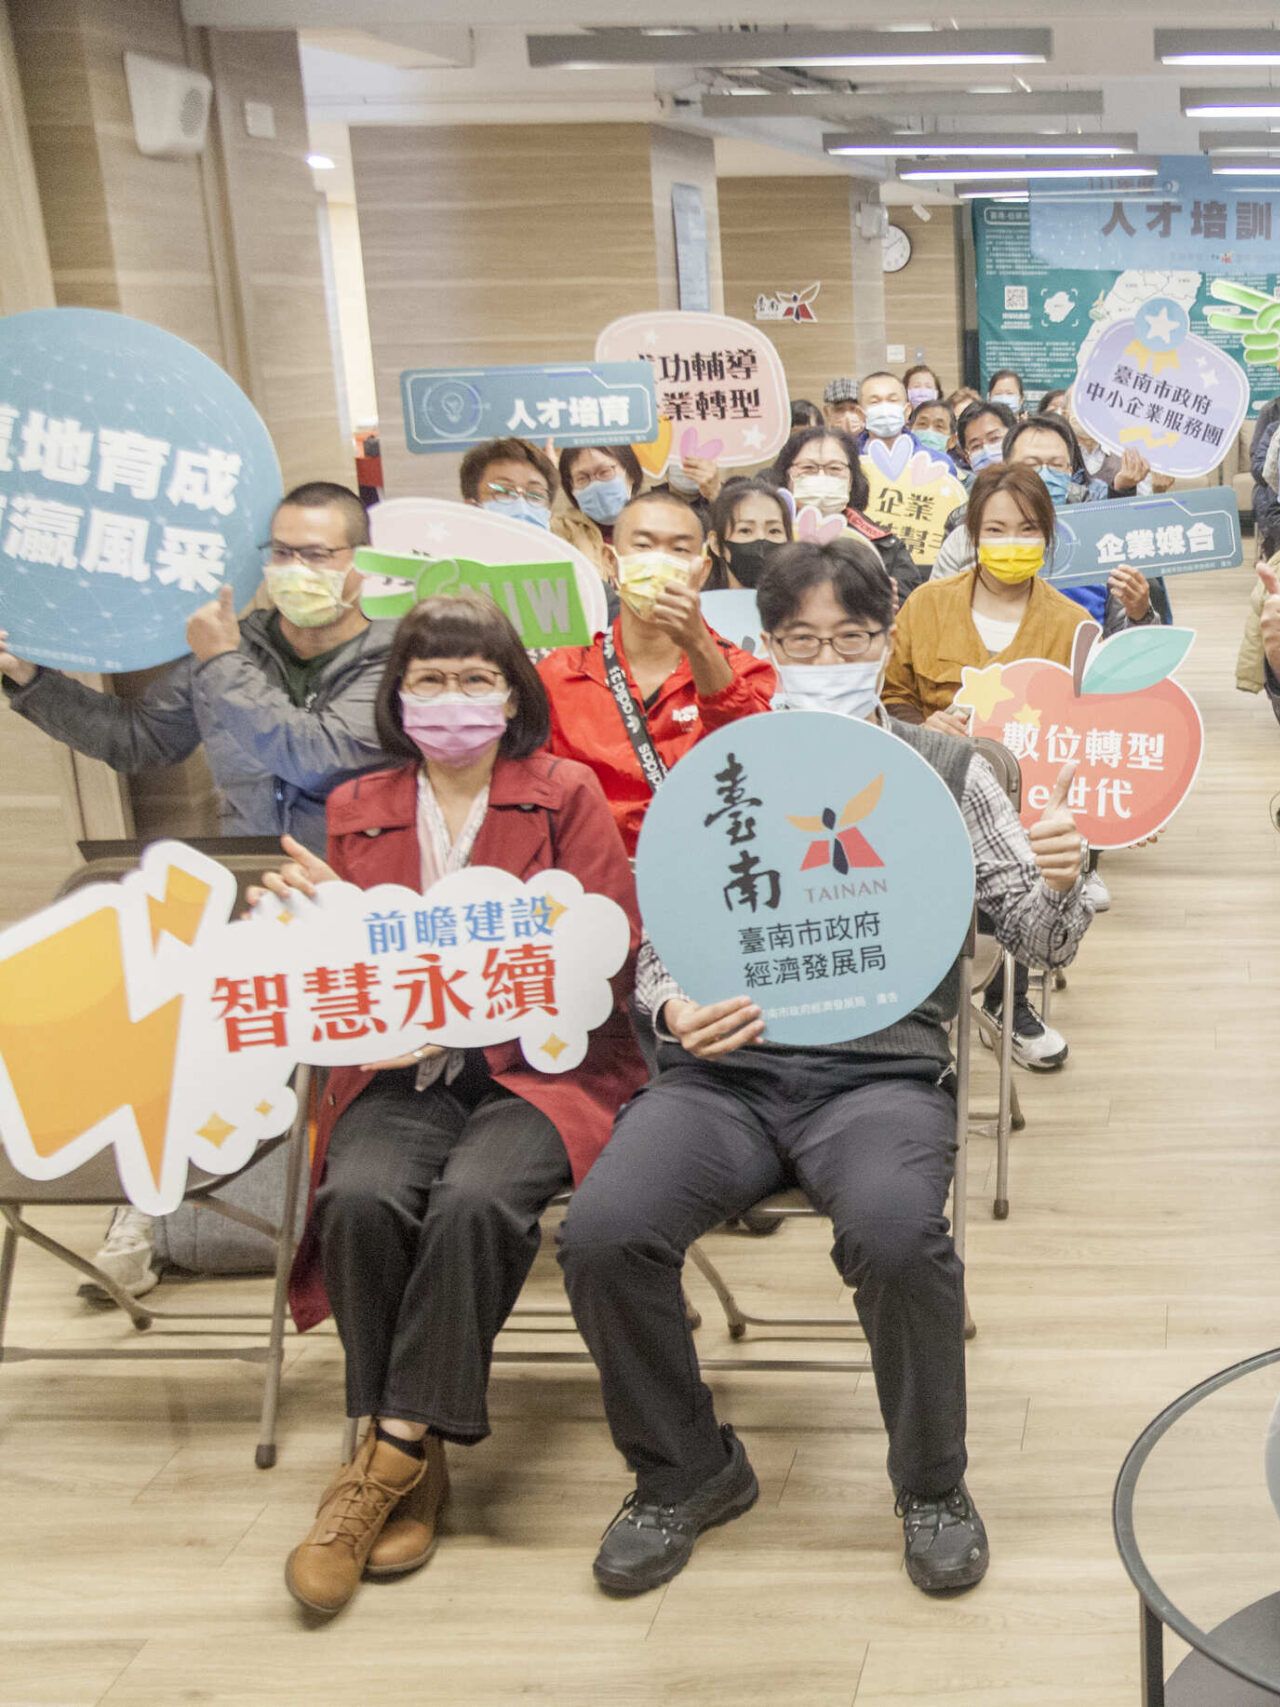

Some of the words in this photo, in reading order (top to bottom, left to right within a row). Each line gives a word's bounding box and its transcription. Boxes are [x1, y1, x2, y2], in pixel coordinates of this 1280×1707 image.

[639, 349, 758, 383] 功輔導
[656, 388, 762, 421] 業轉型
[1112, 363, 1213, 415] 臺南市政府
[506, 395, 631, 431] 人才培育
[1086, 382, 1225, 447] 中小企業服務團
[875, 487, 935, 522] 企業
[0, 494, 227, 594] 瀛風采
[1095, 522, 1215, 563] 企業媒合
[460, 578, 570, 636] IW
[638, 743, 663, 790] didas
[1003, 721, 1165, 771] 數位轉型
[704, 752, 781, 913] 臺南
[804, 878, 888, 904] TAINAN
[364, 895, 554, 955] 前瞻建設
[738, 910, 881, 954] 臺南市政府
[744, 945, 887, 988] 經濟發展局
[211, 944, 560, 1053] 智慧永續
[762, 995, 866, 1020] 南市政府經濟發展局
